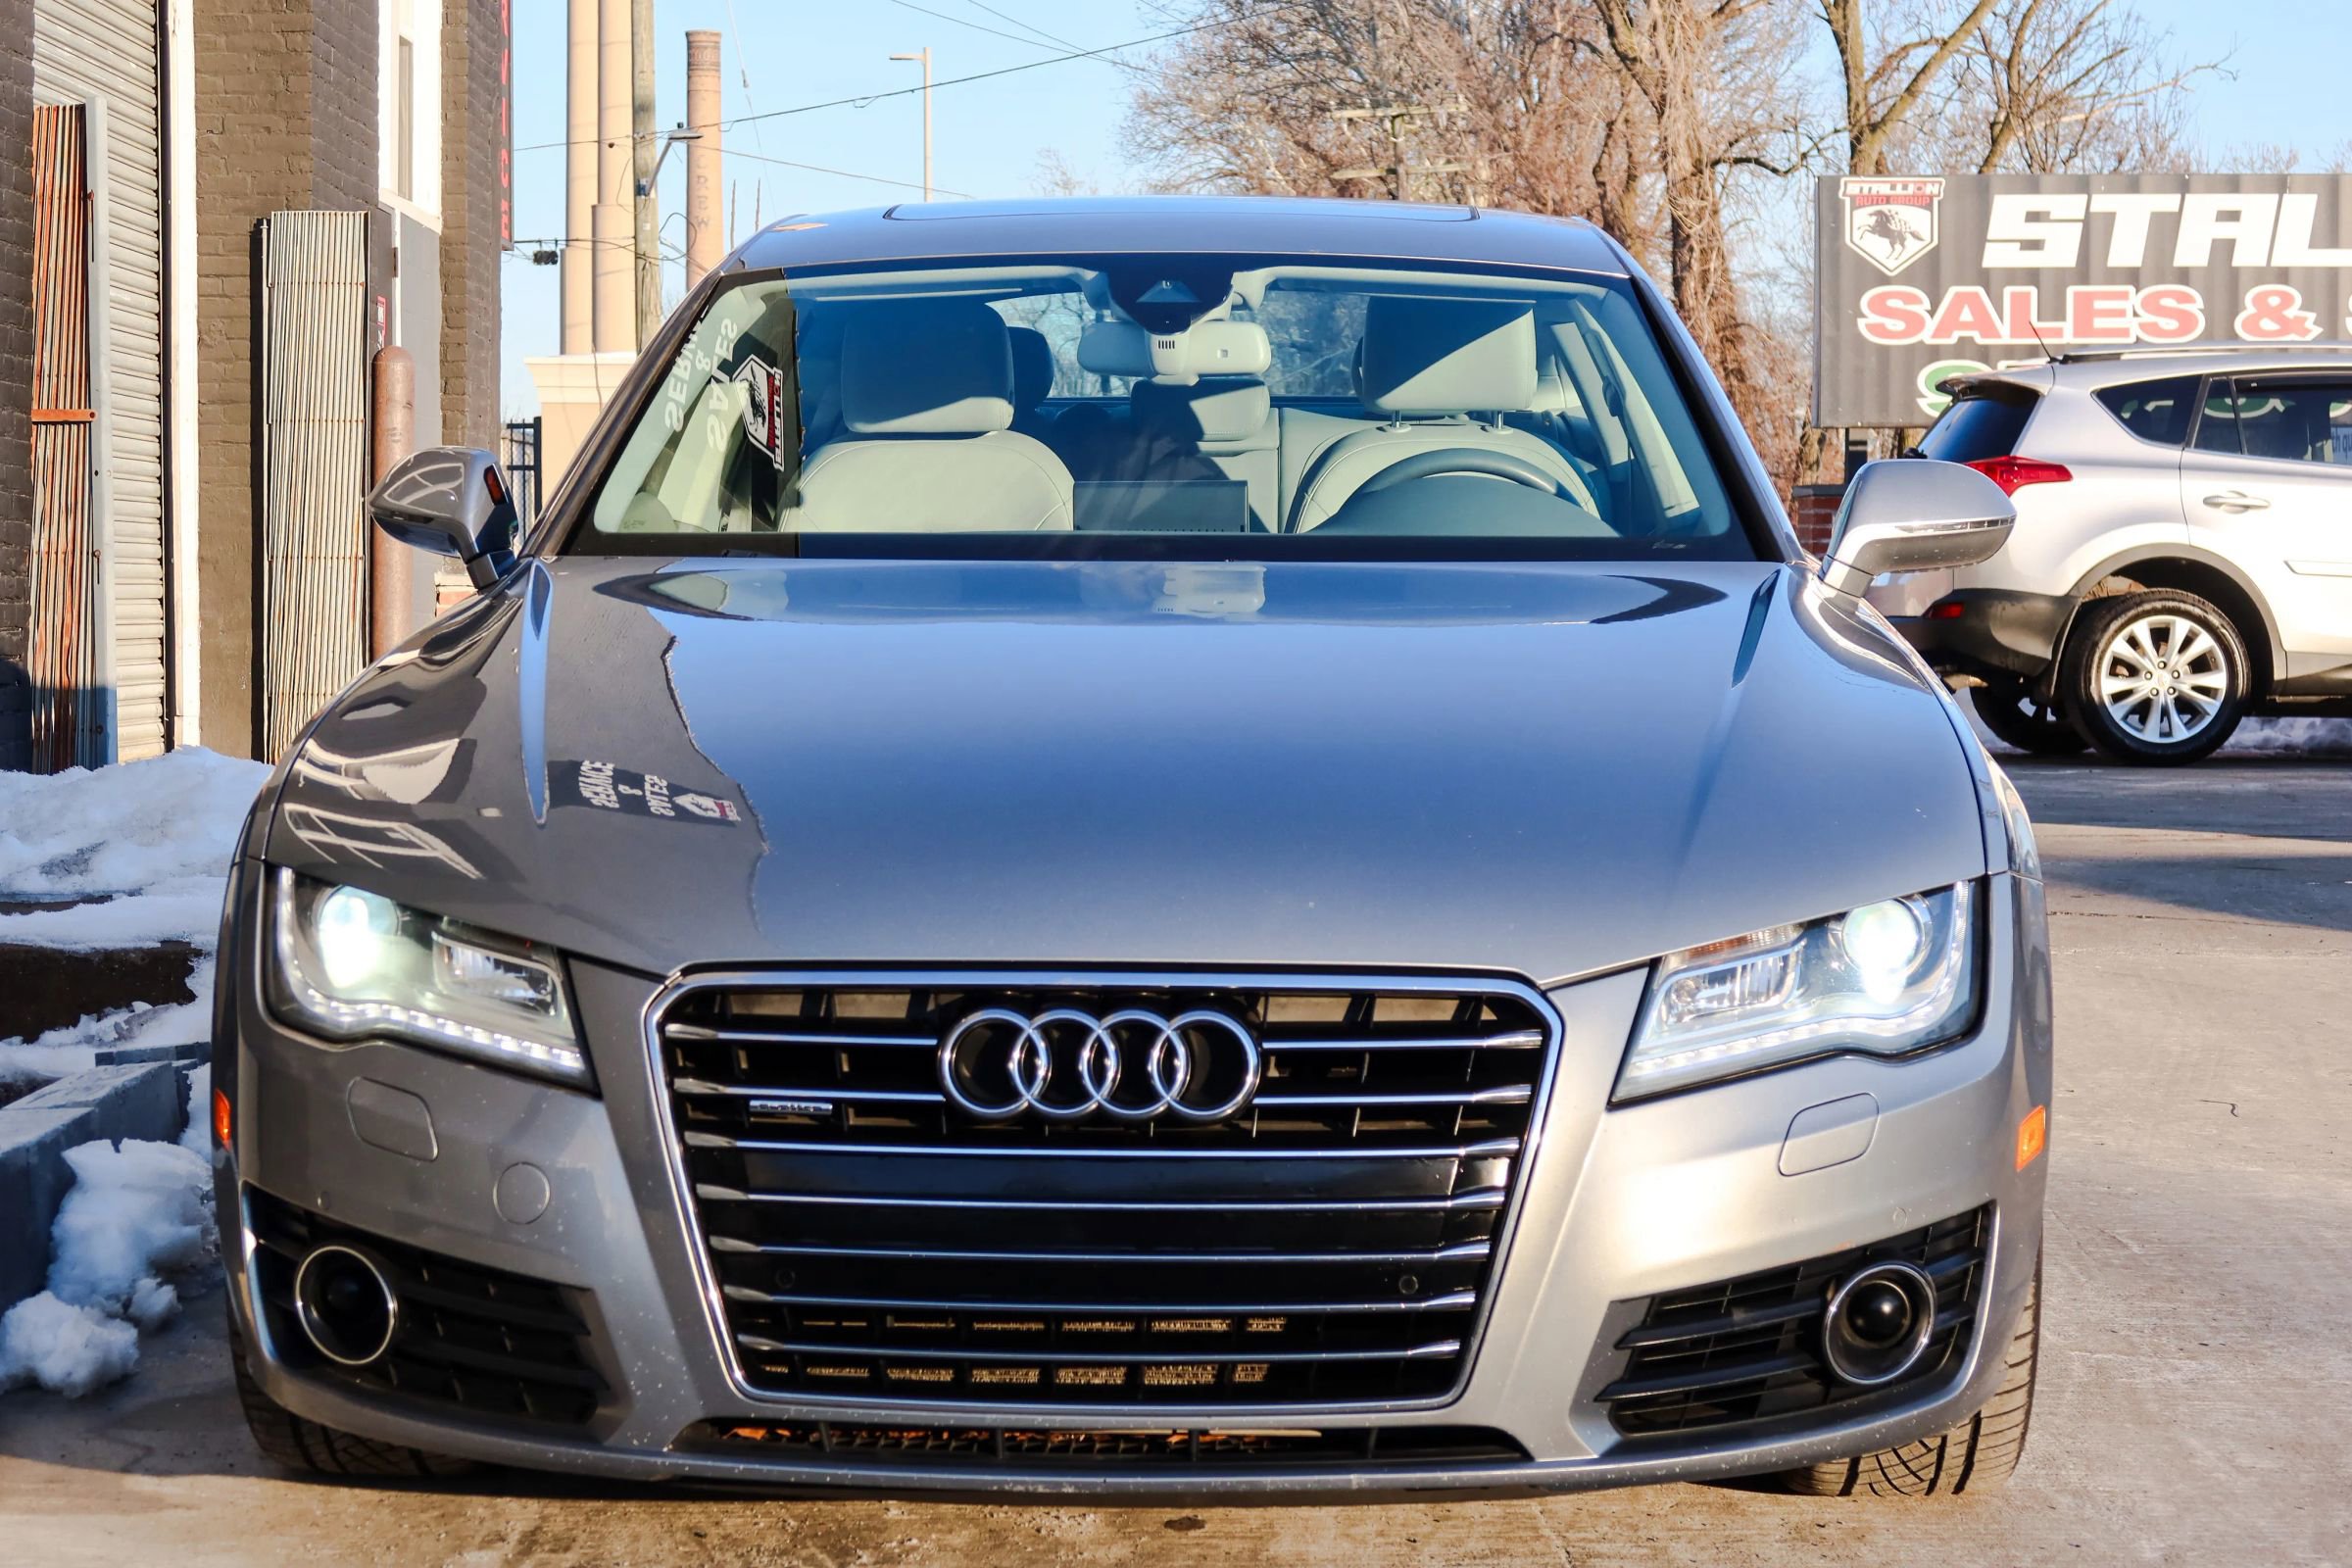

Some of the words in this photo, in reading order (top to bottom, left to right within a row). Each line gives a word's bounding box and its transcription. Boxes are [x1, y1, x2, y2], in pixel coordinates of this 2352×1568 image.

[1845, 182, 1941, 196] STALLION
[1855, 195, 1886, 206] AUTO
[1890, 195, 1931, 206] GROUP
[1857, 284, 2206, 345] SALES
[2233, 283, 2325, 342] &
